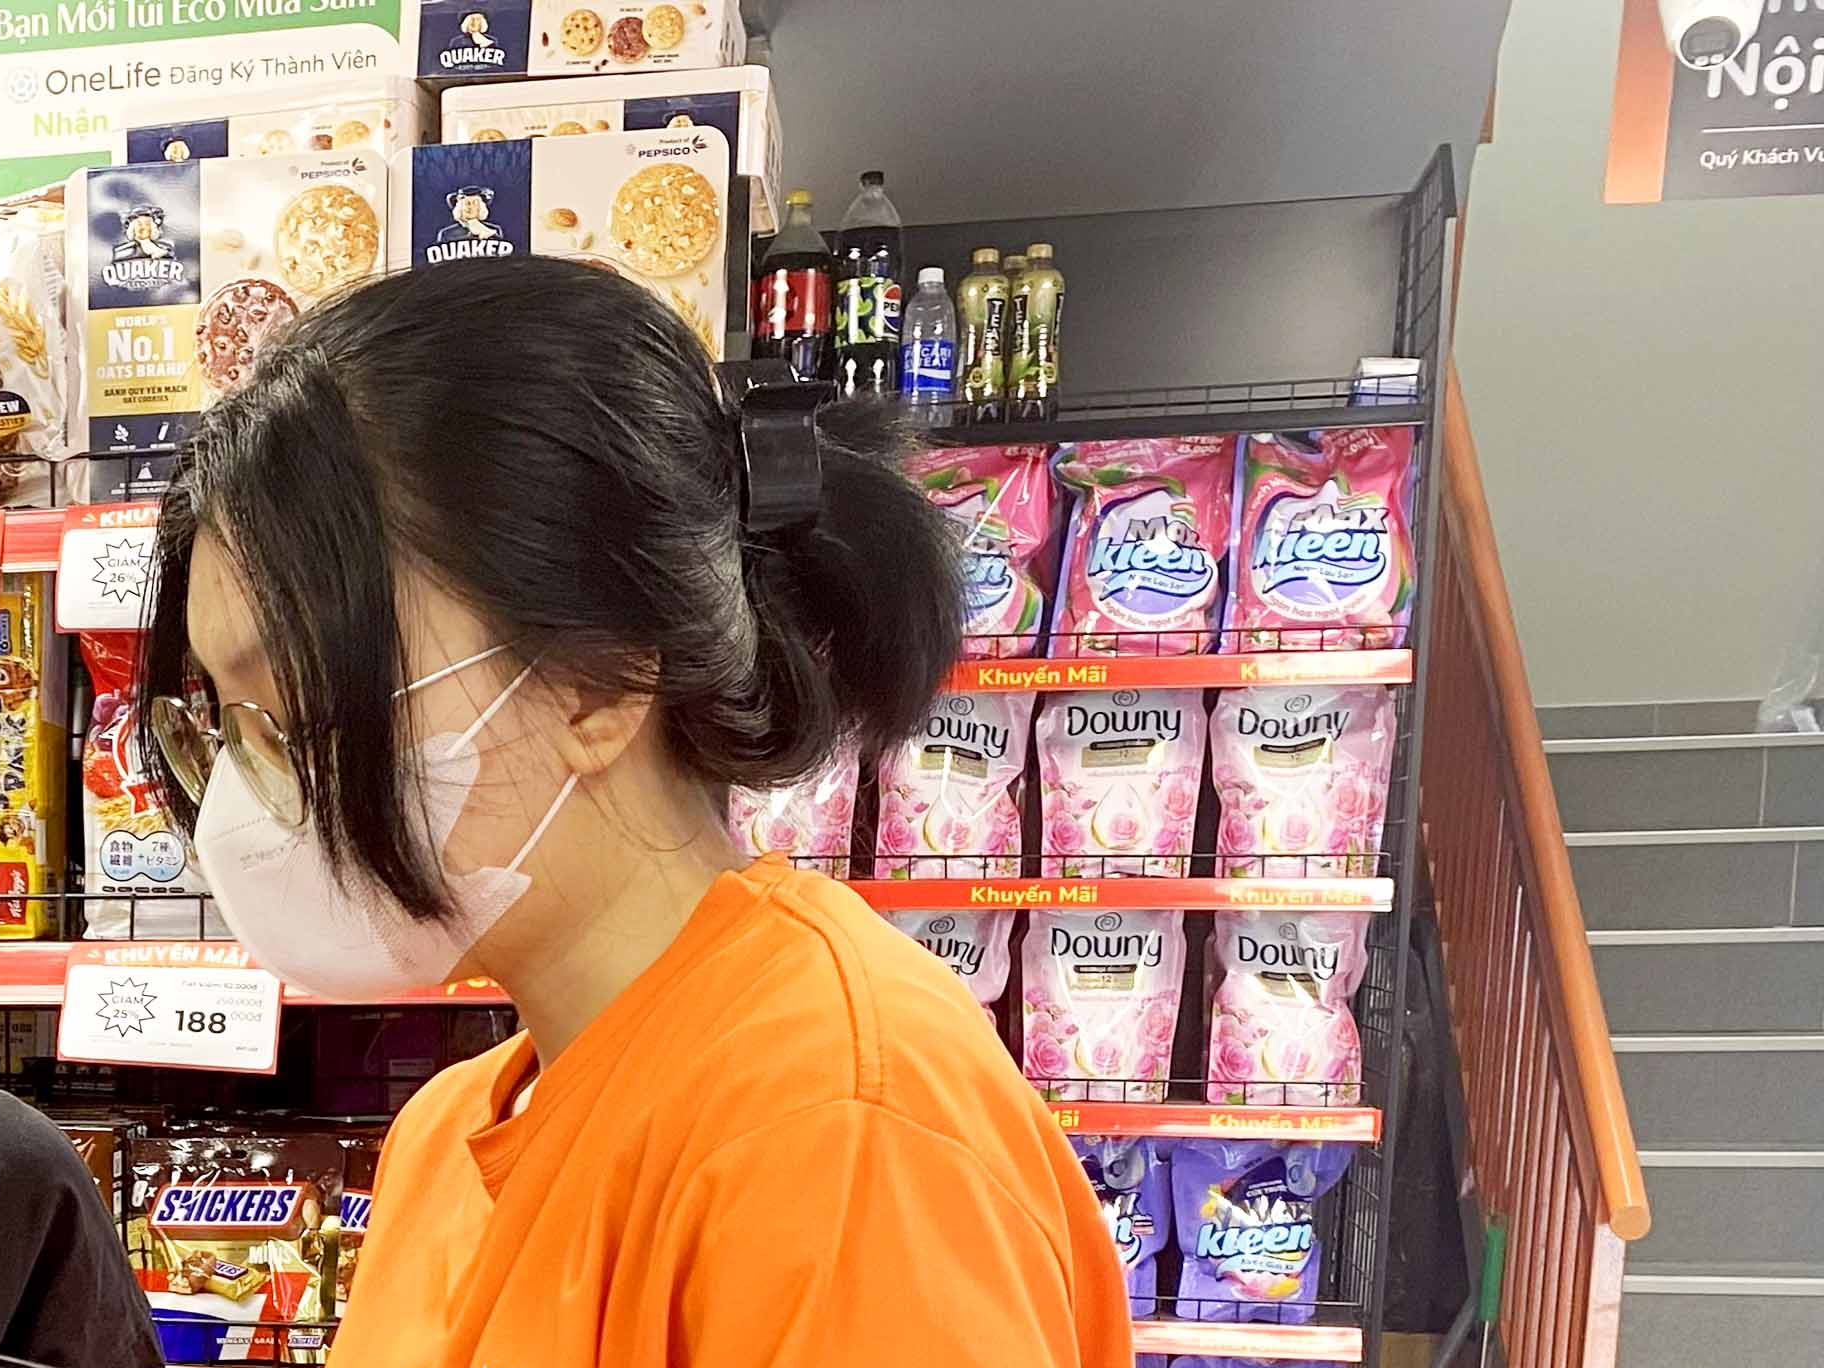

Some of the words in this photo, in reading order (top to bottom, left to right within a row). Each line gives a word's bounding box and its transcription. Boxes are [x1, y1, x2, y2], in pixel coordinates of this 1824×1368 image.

[56, 0, 117, 34] Mới
[171, 0, 226, 26] Eco
[45, 60, 161, 96] OneLife
[169, 63, 224, 86] Đăng
[229, 57, 255, 82] Ký
[261, 54, 325, 78] Thành
[331, 48, 377, 71] Viên
[438, 46, 506, 69] QUAKER
[637, 146, 692, 159] PEPSICO
[1699, 148, 1738, 170] Quý
[1741, 146, 1800, 166] Khách
[101, 259, 185, 287] QUAKER
[106, 326, 175, 365] No.1
[978, 665, 1062, 687] Khuyến
[1068, 664, 1108, 684] Mãi
[1066, 703, 1183, 741] Downy
[1237, 705, 1351, 742] Downy
[970, 884, 1053, 908] Khuyến
[1058, 882, 1099, 904] Mãi
[103, 944, 199, 966] KHUYẾN
[1049, 925, 1164, 969] Downy
[1235, 934, 1340, 980] Downy
[175, 1009, 227, 1034] 188
[156, 1188, 297, 1223] SNICKERS
[1195, 1220, 1314, 1260] kleen
